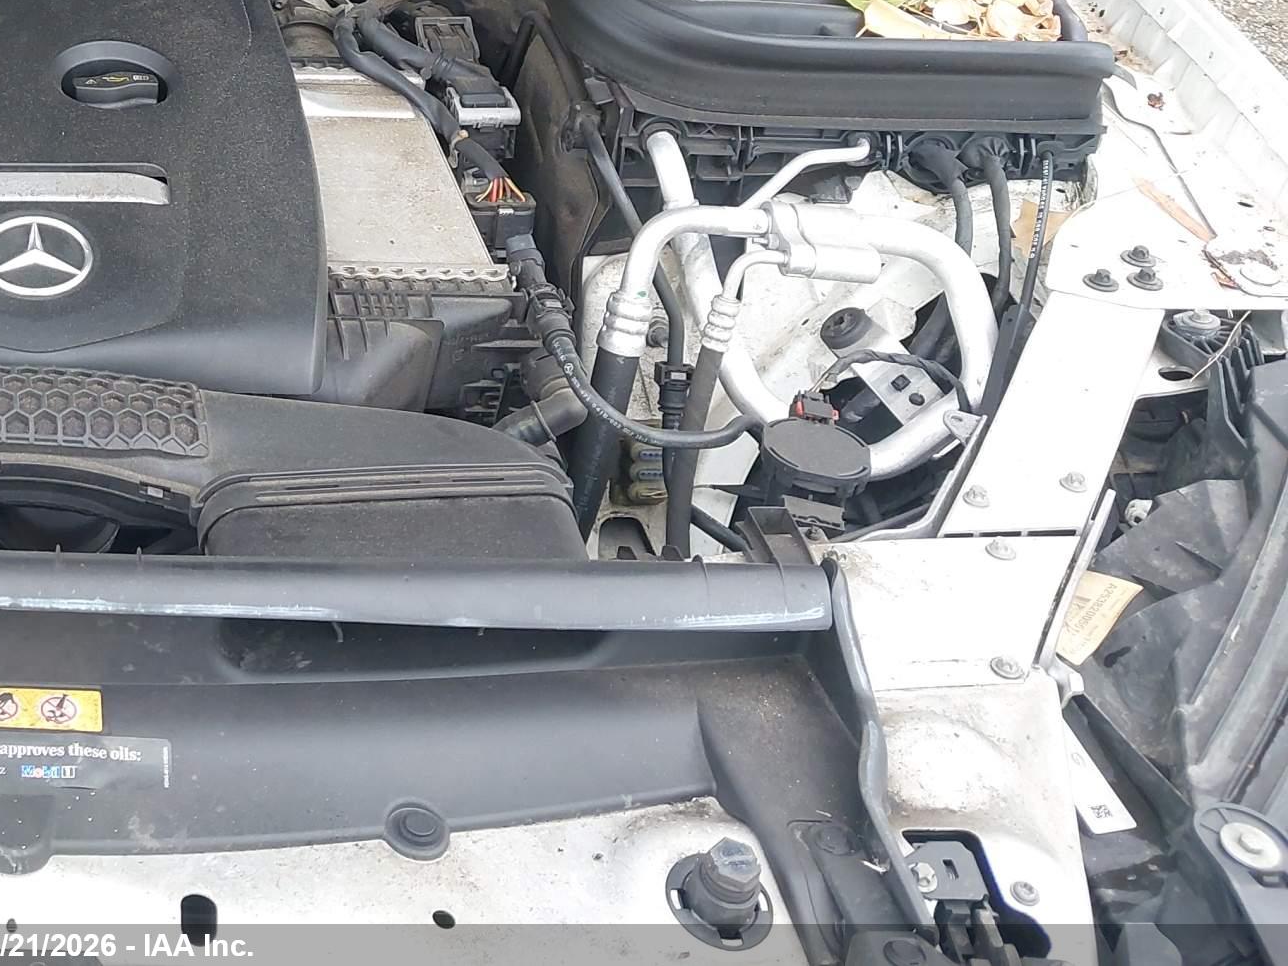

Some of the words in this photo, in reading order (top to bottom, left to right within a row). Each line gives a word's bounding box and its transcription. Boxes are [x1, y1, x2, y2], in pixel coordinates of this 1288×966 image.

[0, 744, 65, 759] approves
[68, 743, 108, 760] these
[109, 746, 143, 762] oils:
